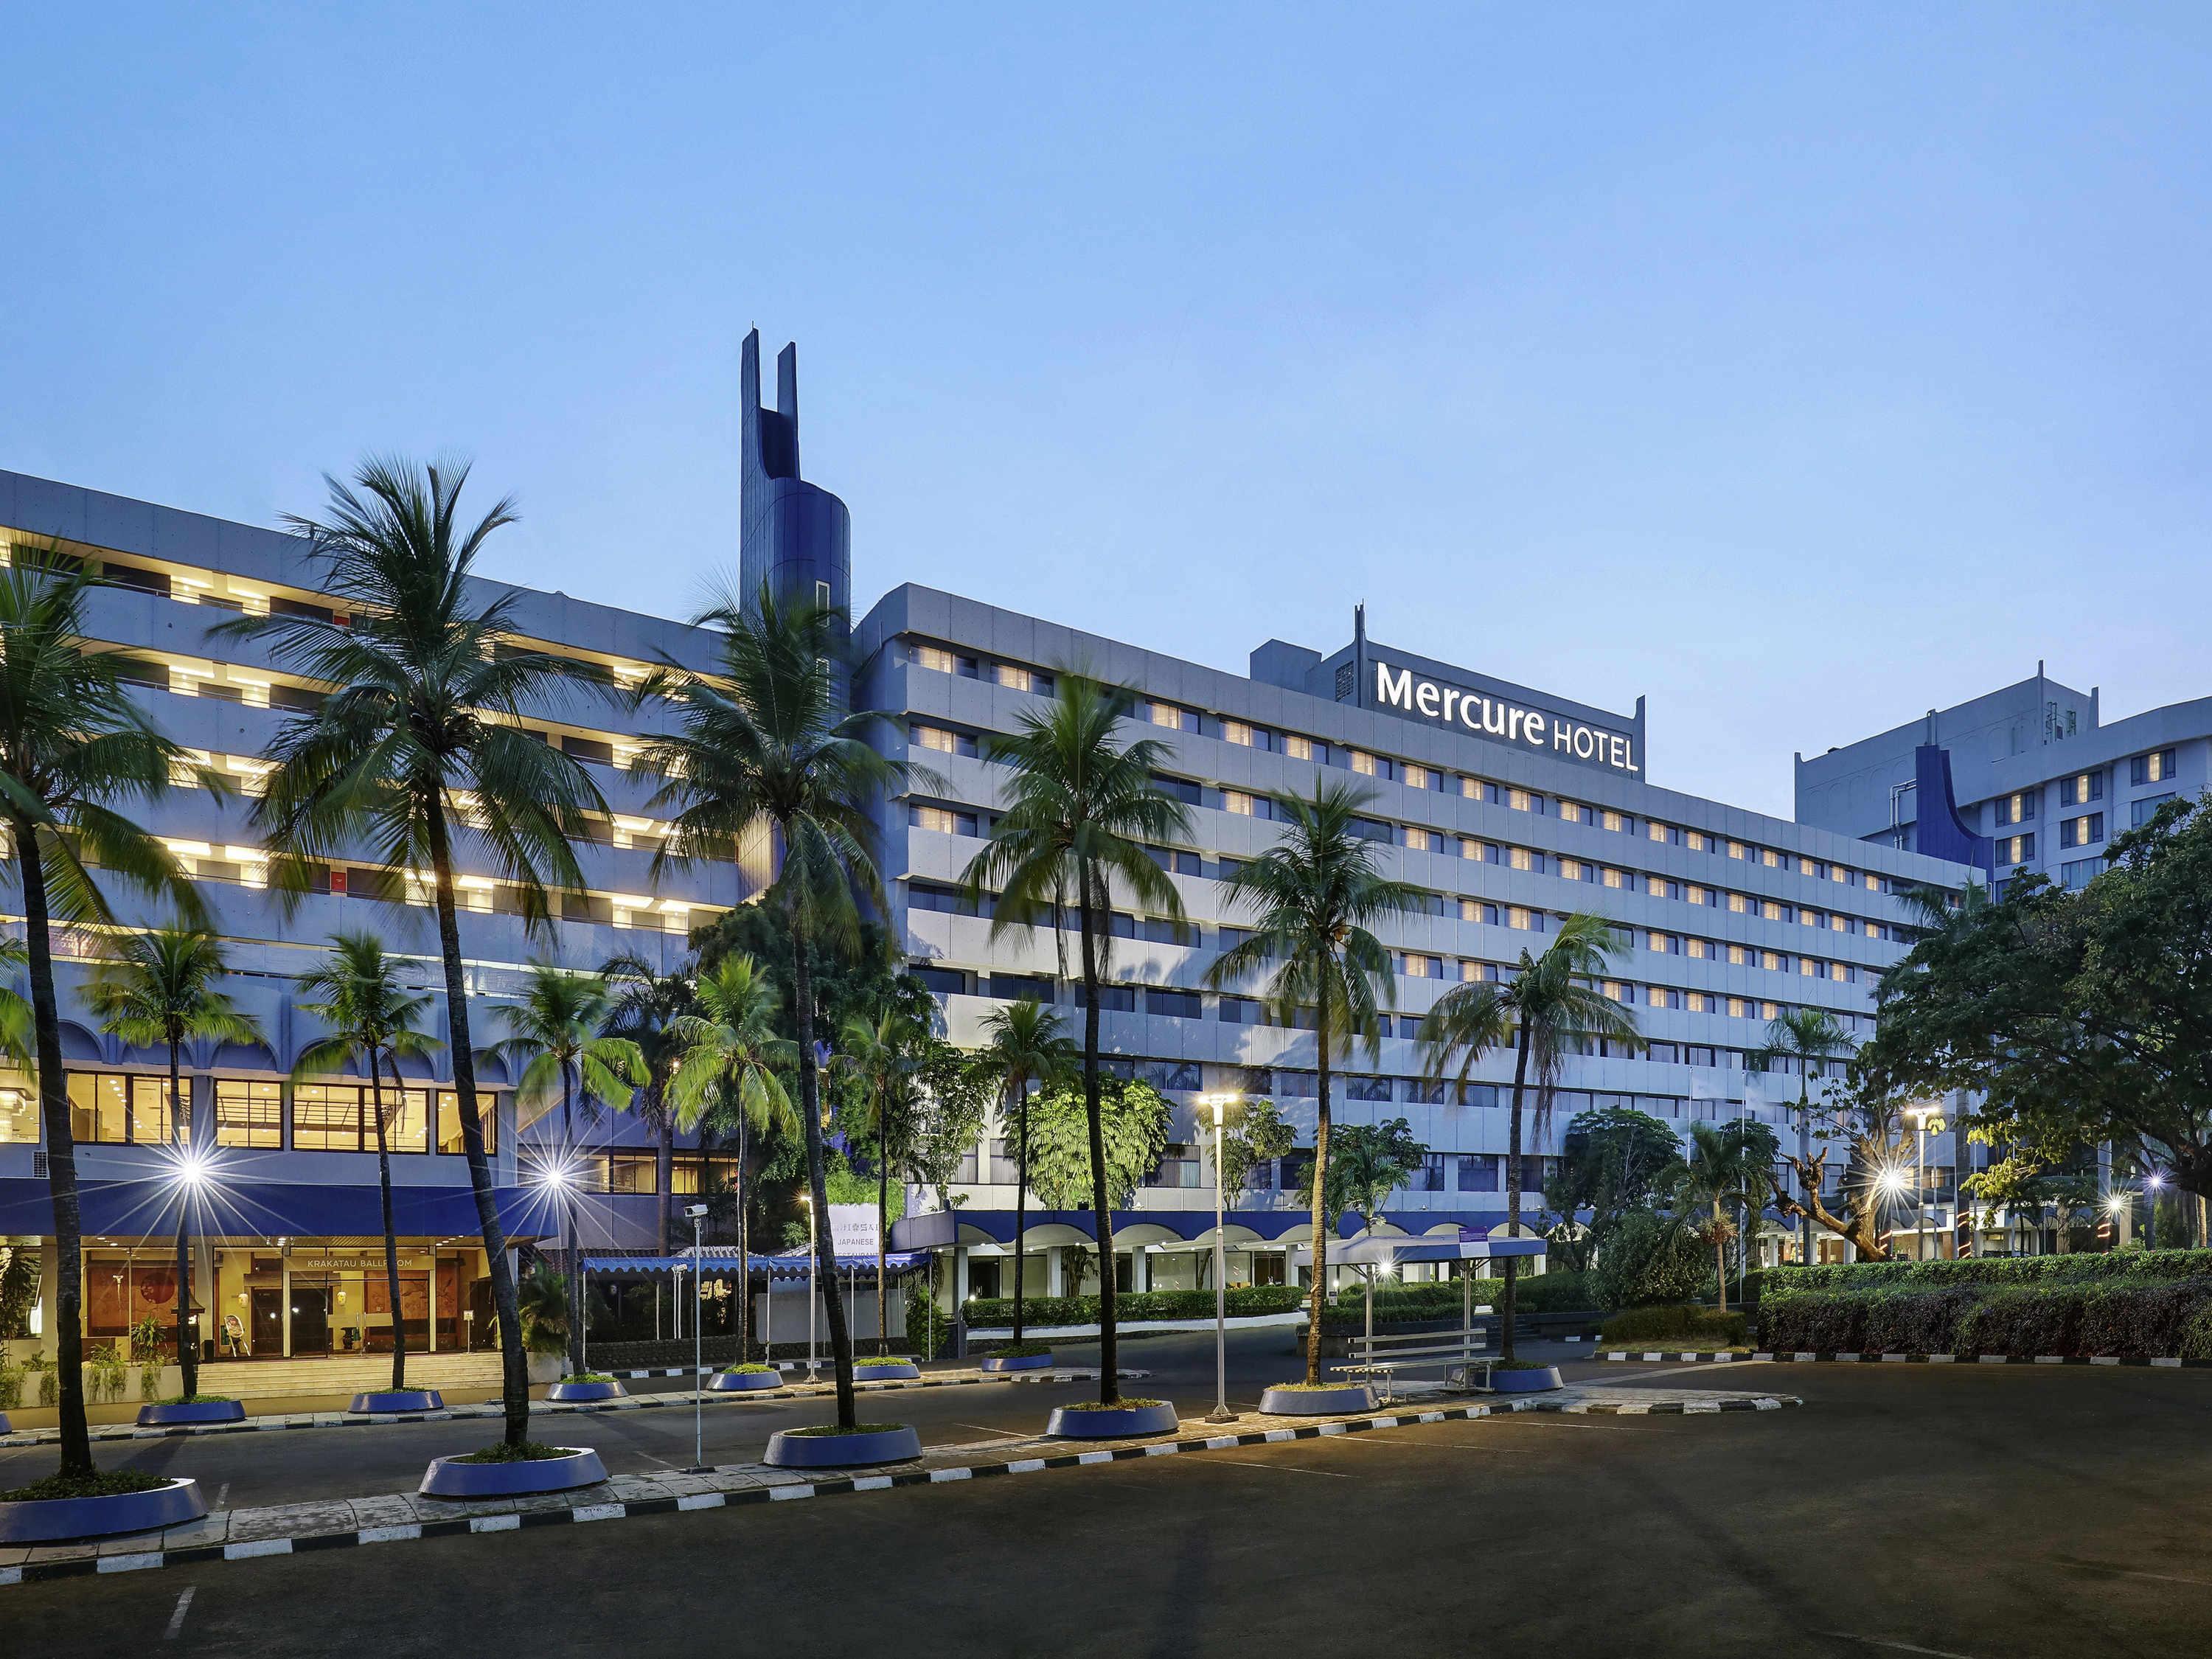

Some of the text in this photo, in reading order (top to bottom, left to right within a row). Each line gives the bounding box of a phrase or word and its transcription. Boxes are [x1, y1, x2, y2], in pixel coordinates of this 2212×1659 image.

[1377, 661, 1639, 772] Mercure HOTEL
[307, 1259, 356, 1267] KRAKATAU
